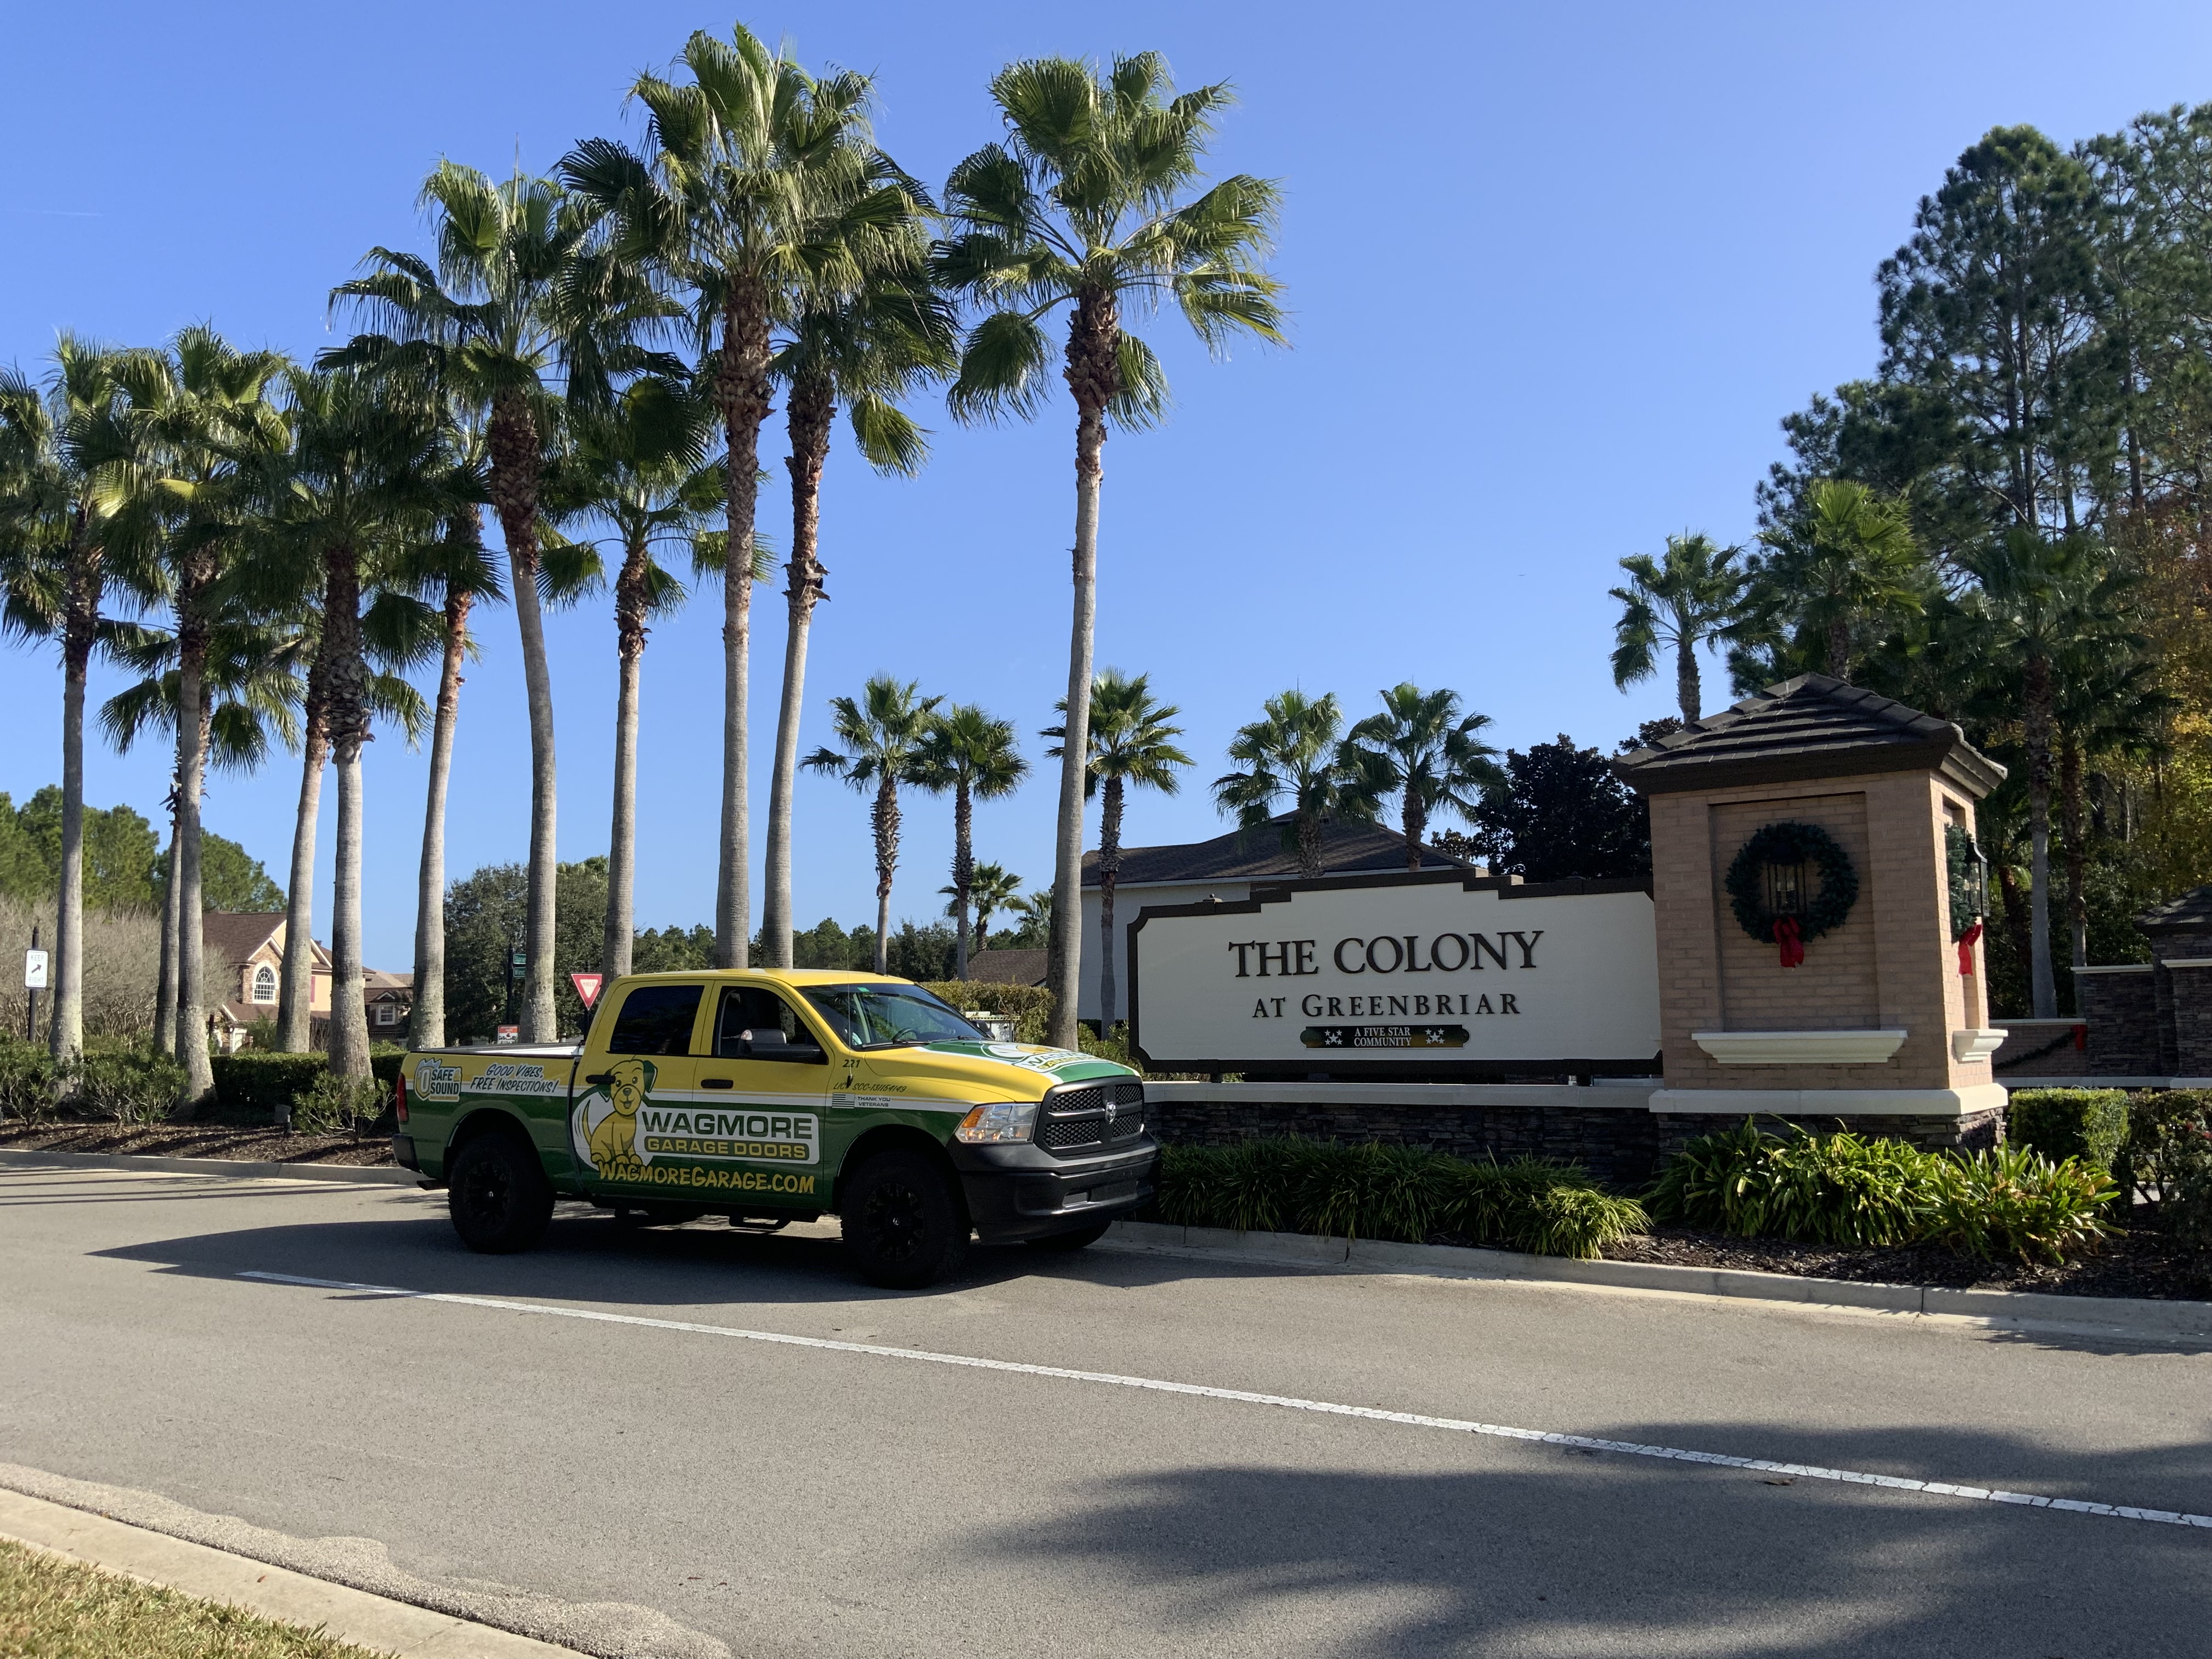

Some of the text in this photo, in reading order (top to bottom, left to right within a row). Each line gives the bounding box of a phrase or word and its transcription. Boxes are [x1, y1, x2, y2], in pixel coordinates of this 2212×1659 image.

[1228, 930, 1544, 978] THE COLONY
[1252, 994, 1520, 1018] AT GREENBRIAR
[1355, 1027, 1410, 1037] A FIVE STAR
[1354, 1037, 1412, 1047] COMMUNITY
[487, 1064, 543, 1078] GOOD VIBES,
[843, 1059, 860, 1068] 221
[432, 1069, 454, 1081] SAFE
[430, 1082, 459, 1094] SOUND
[470, 1077, 559, 1093] FREE INSPECTIONS!
[641, 1111, 812, 1139] WAGMORE
[647, 1138, 806, 1158] GARAGE DOORS
[599, 1161, 815, 1194] WAGMOREGARAGE.COM
